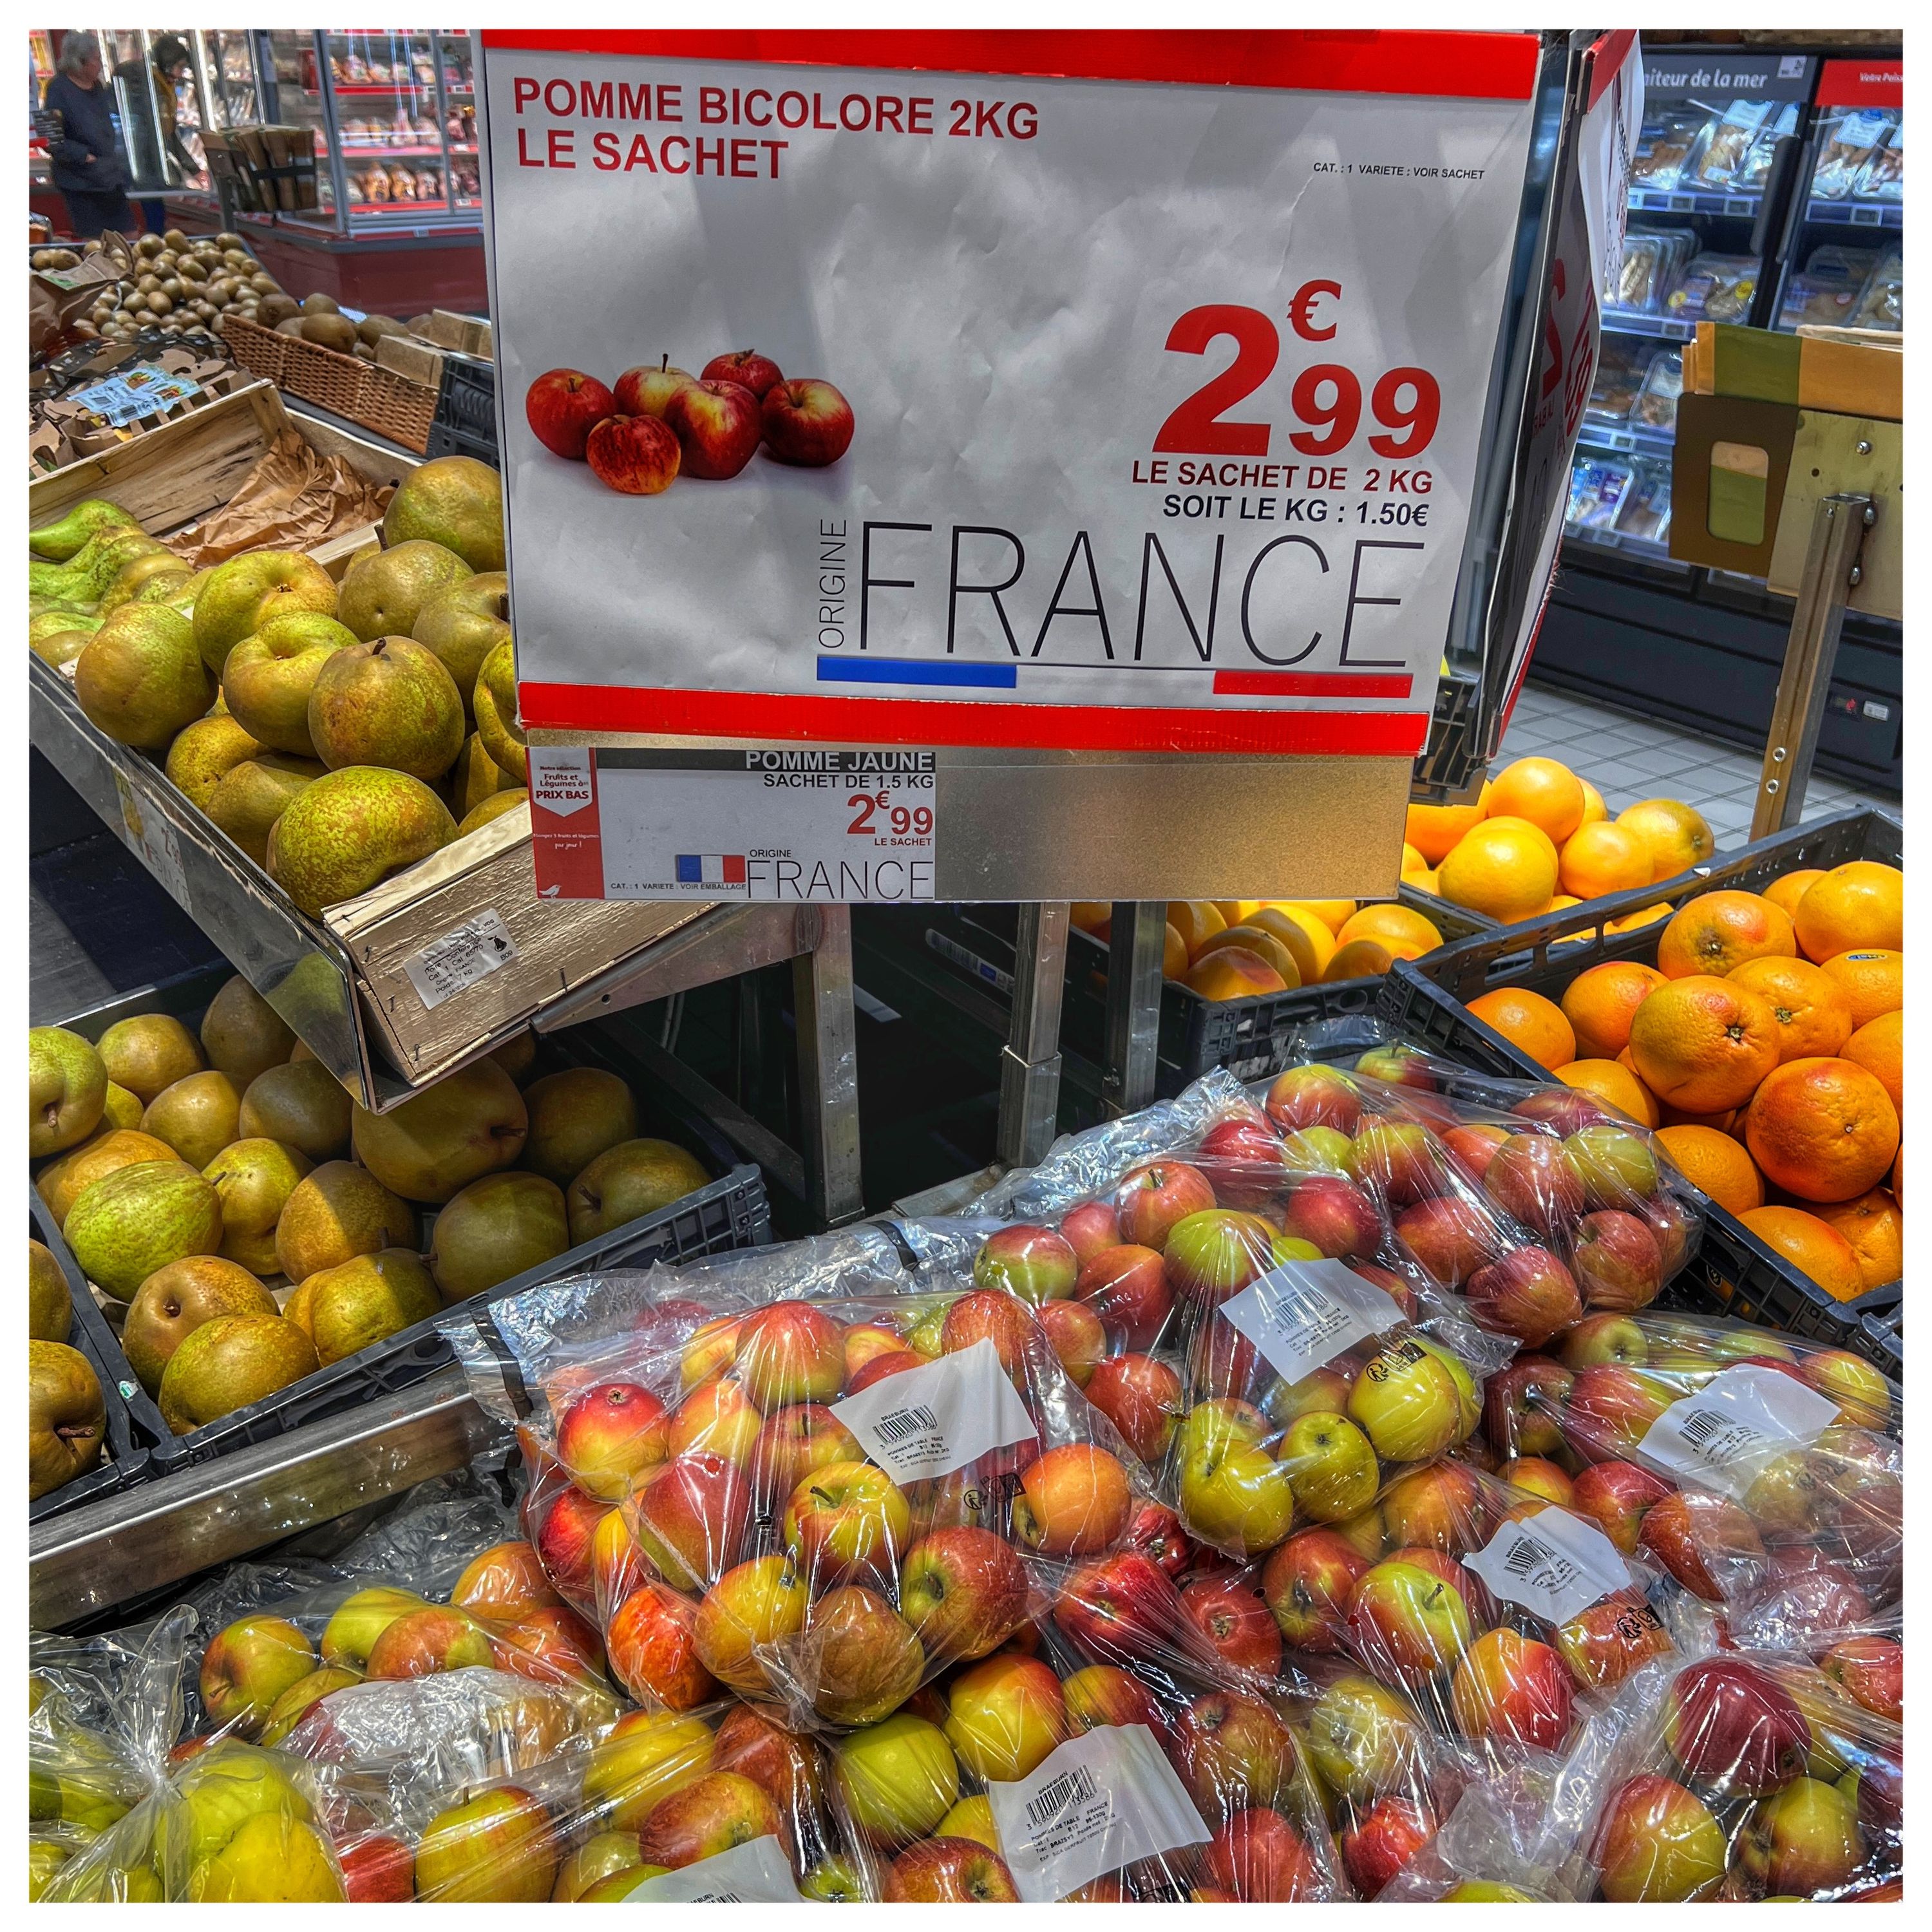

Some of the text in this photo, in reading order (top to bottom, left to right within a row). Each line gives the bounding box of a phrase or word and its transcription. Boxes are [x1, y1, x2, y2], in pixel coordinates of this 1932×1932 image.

[1690, 68, 1710, 88] de
[1714, 68, 1732, 87] la
[1733, 73, 1768, 88] mer
[515, 77, 1039, 139] POMME BICOLORE 2KG
[518, 129, 789, 178] LE SACHET
[1313, 162, 1338, 173] CAT.
[1347, 164, 1352, 173] 1
[1359, 164, 1405, 176] VARIETE
[1414, 167, 1438, 178] VOIR
[1441, 168, 1485, 180] SACHET
[1151, 304, 1441, 460] 2 99
[1132, 461, 1433, 493] LE SACHET DE 2 KG
[1162, 494, 1232, 520] SOIT
[1240, 497, 1274, 520] LE
[1284, 499, 1328, 522] KG
[1356, 502, 1429, 527] 1.50€
[819, 520, 847, 648] ORIGINE
[860, 522, 1424, 668] FRANCE
[746, 751, 933, 772] POMME JAUNE
[536, 790, 589, 799] PRIX BAS
[764, 775, 934, 788] SACHET DE 1.5 KG
[847, 794, 933, 835] 2 99
[750, 849, 791, 858] ORIGINE
[748, 860, 934, 900] FRANCE
[881, 1408, 908, 1421] BRAEBURN
[1038, 1771, 1068, 1794] BRAEBURN
[1063, 1815, 1080, 1826] TABLE
[1086, 1801, 1108, 1815] FRANCE
